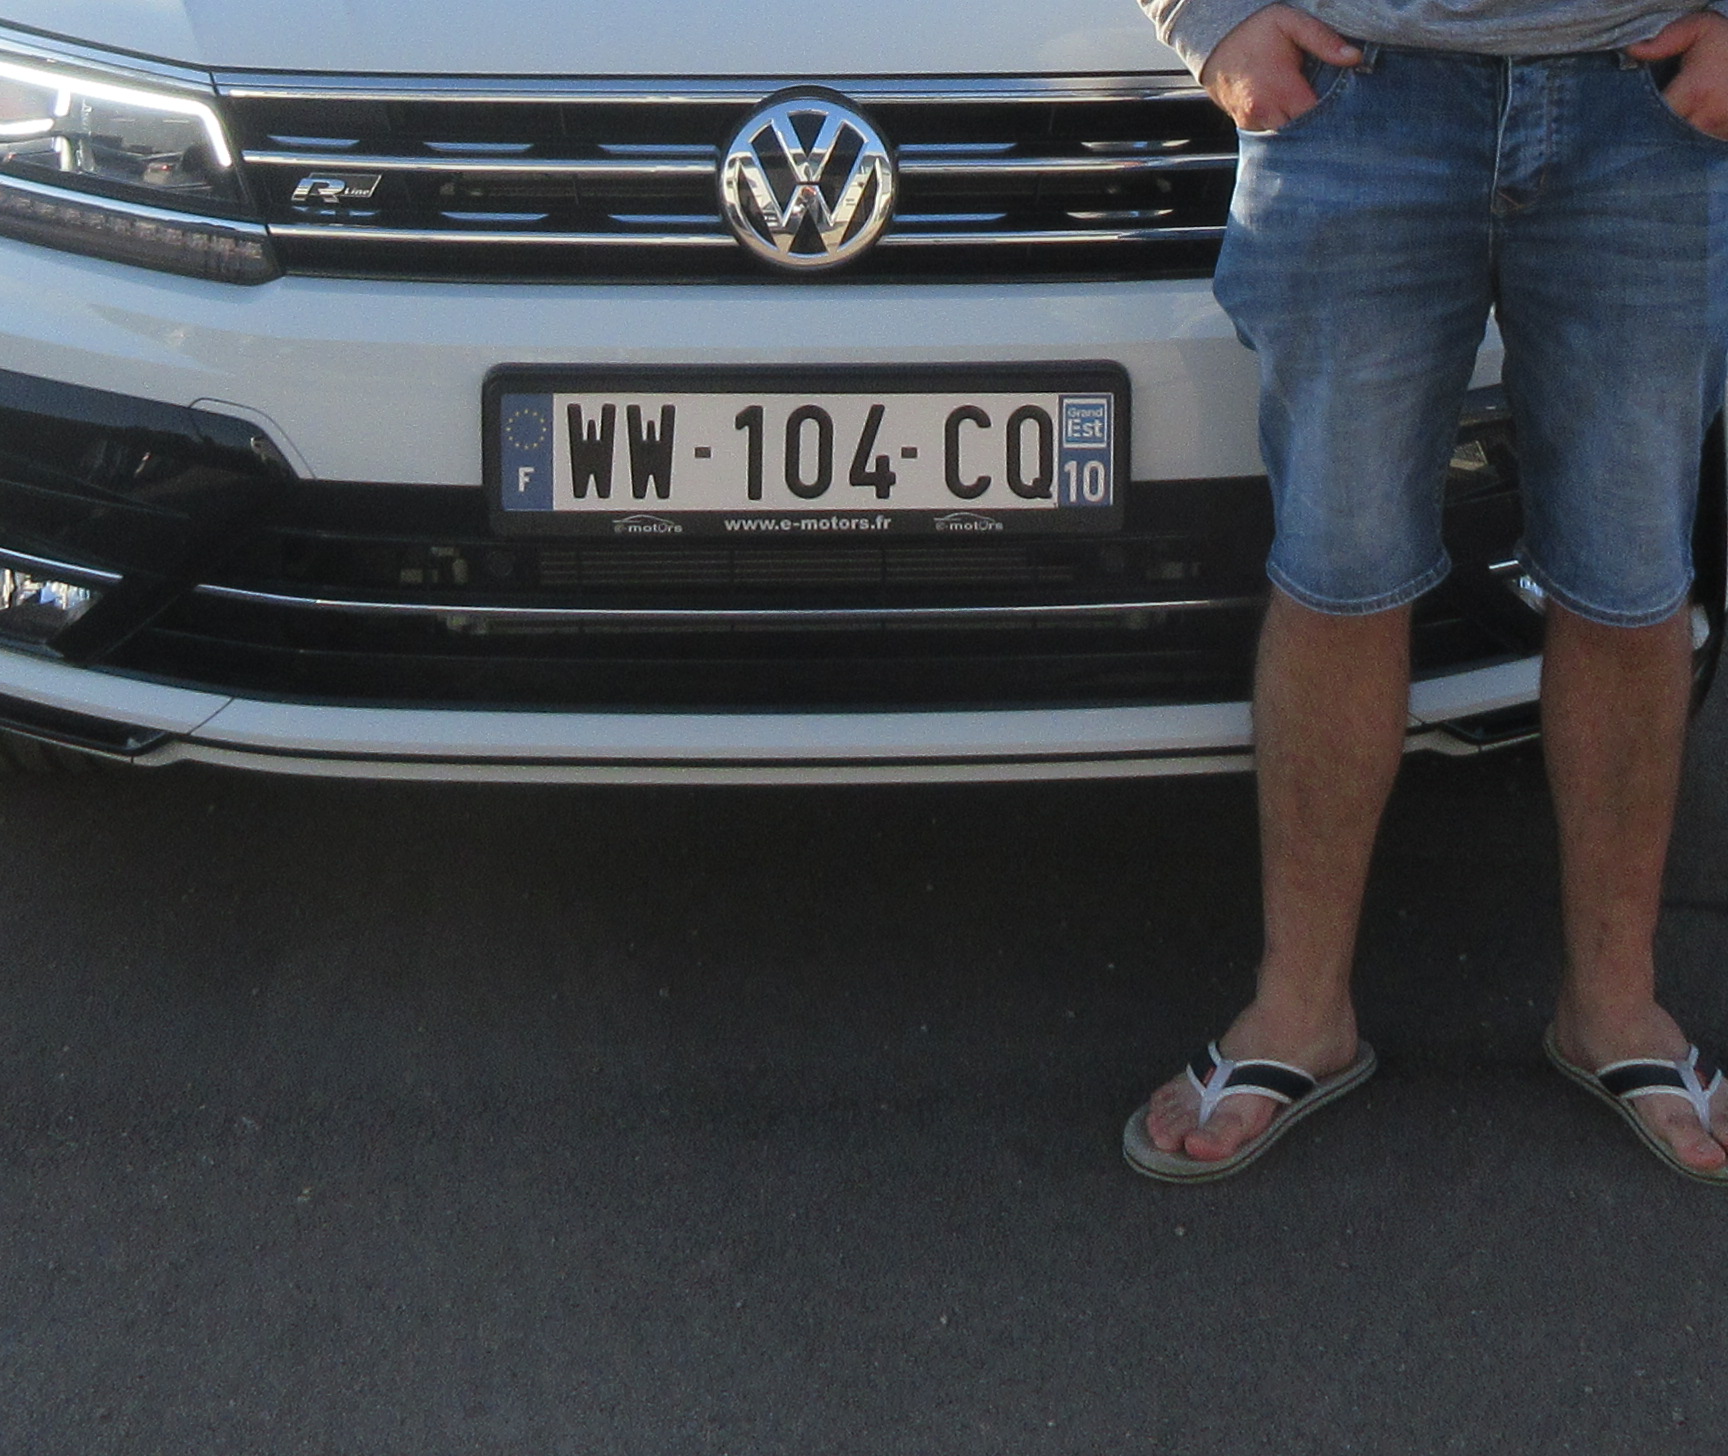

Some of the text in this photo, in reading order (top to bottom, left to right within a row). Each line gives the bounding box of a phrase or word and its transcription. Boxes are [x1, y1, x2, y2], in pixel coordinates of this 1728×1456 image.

[291, 177, 346, 204] R
[1067, 407, 1104, 418] Grand
[1067, 418, 1104, 438] Est
[566, 403, 1054, 501] WW-104-CQ
[517, 466, 535, 493] F
[1064, 460, 1106, 503] 10
[724, 515, 892, 532] www.e-motors.fr
